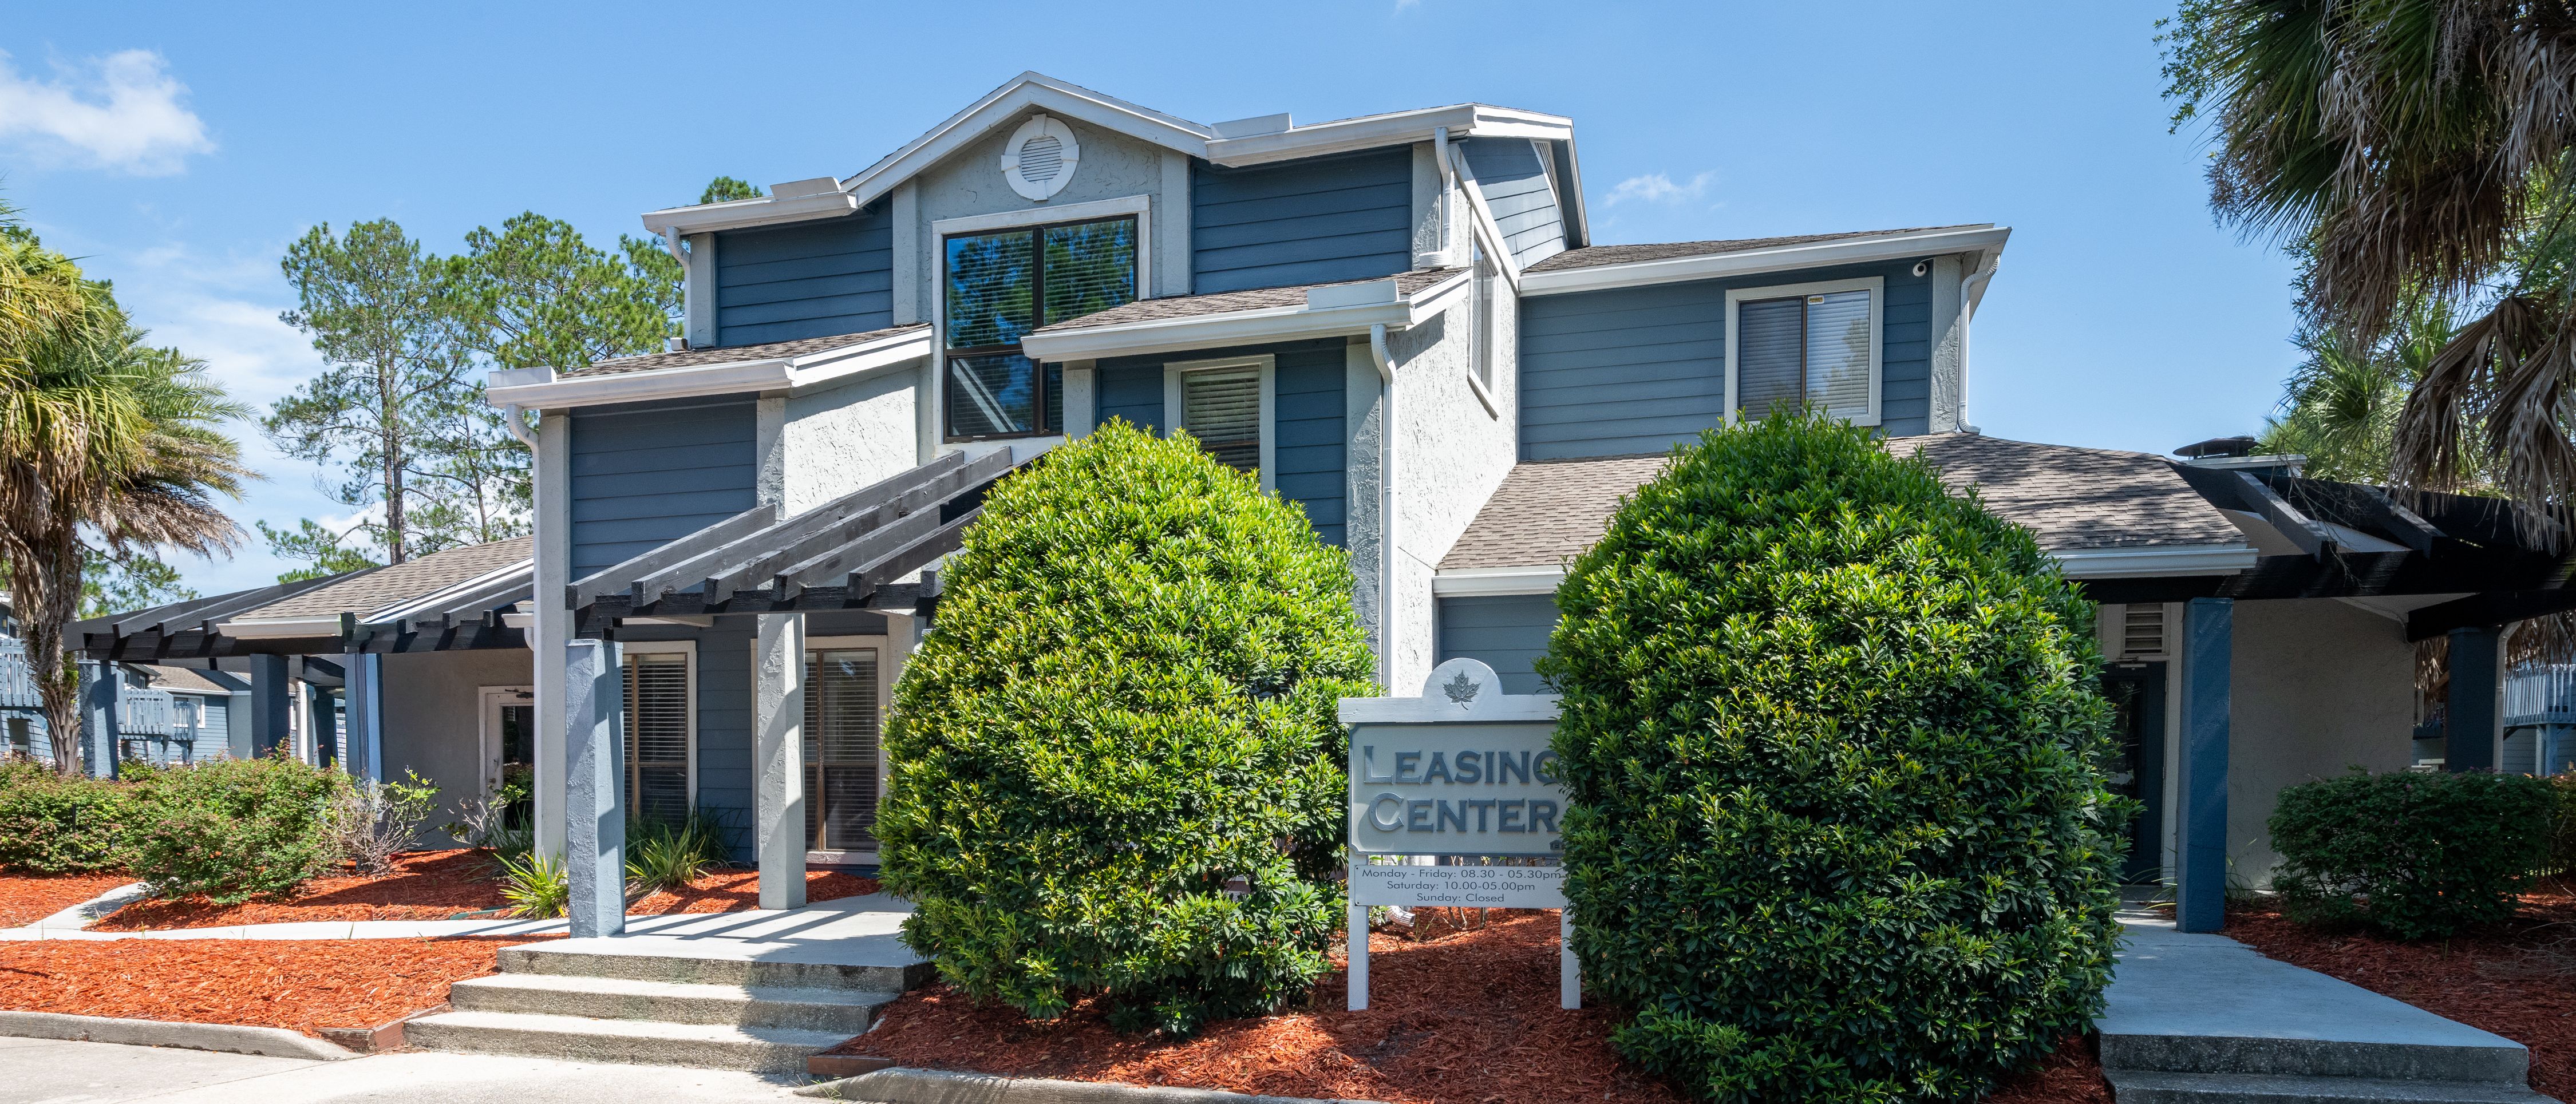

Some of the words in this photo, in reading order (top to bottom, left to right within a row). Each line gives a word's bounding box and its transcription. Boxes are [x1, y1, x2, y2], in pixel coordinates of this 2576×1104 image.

[1369, 792, 1558, 833] CENTER
[1362, 869, 1406, 879] Monday
[1420, 869, 1456, 880] Friday:
[1461, 869, 1495, 878] 08.30
[1508, 870, 1561, 880] 05.30pm
[1387, 880, 1439, 891] Saturday:
[1445, 881, 1535, 892] 10.00-05.00pm
[1417, 893, 1461, 904] Sunday:
[1465, 893, 1504, 902] Closed
